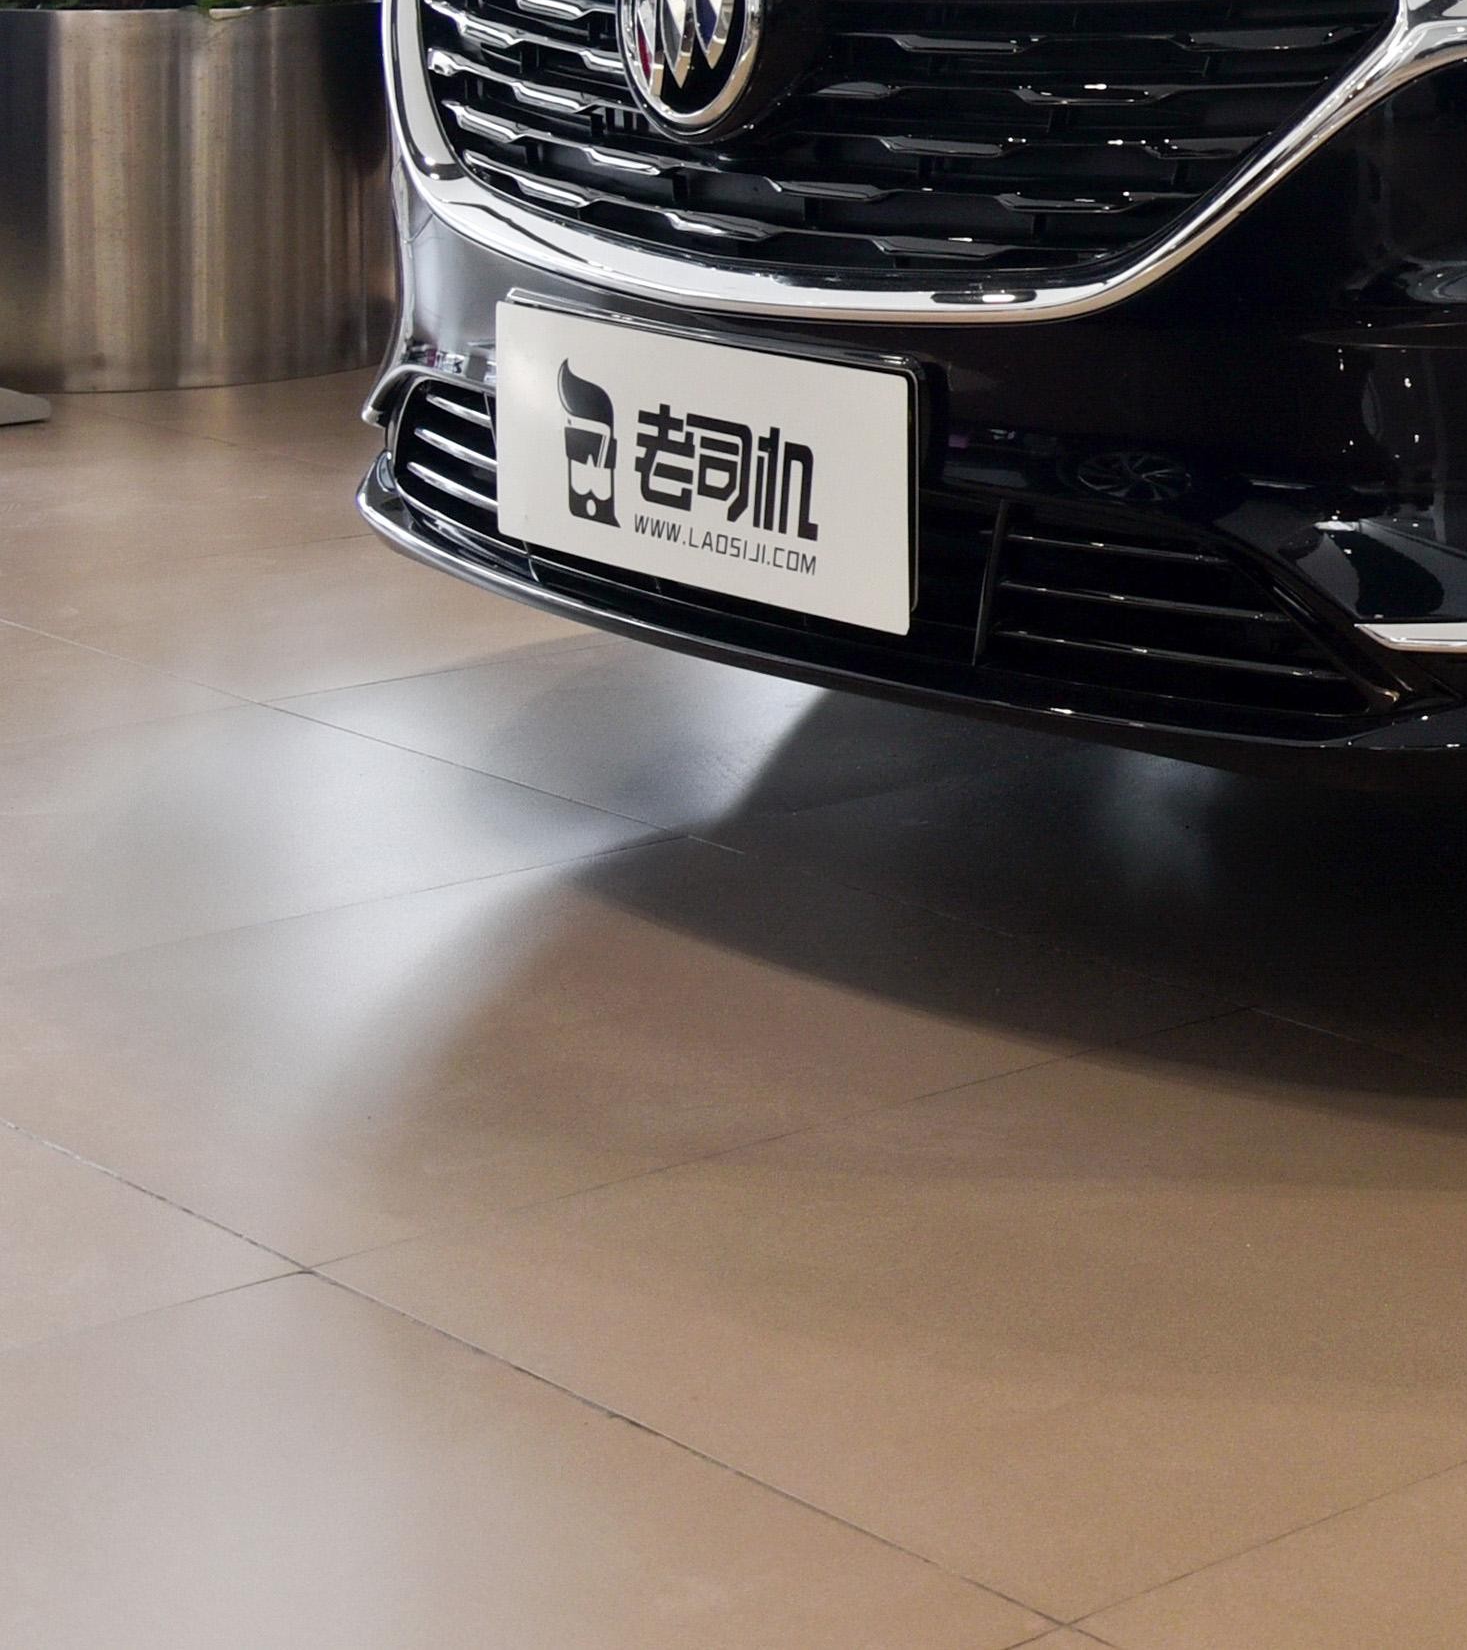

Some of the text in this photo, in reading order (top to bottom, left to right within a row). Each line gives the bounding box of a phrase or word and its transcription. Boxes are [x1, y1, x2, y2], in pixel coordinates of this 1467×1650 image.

[634, 403, 819, 542] 老司机
[634, 512, 818, 577] WWW.LAOSIJI.COM
